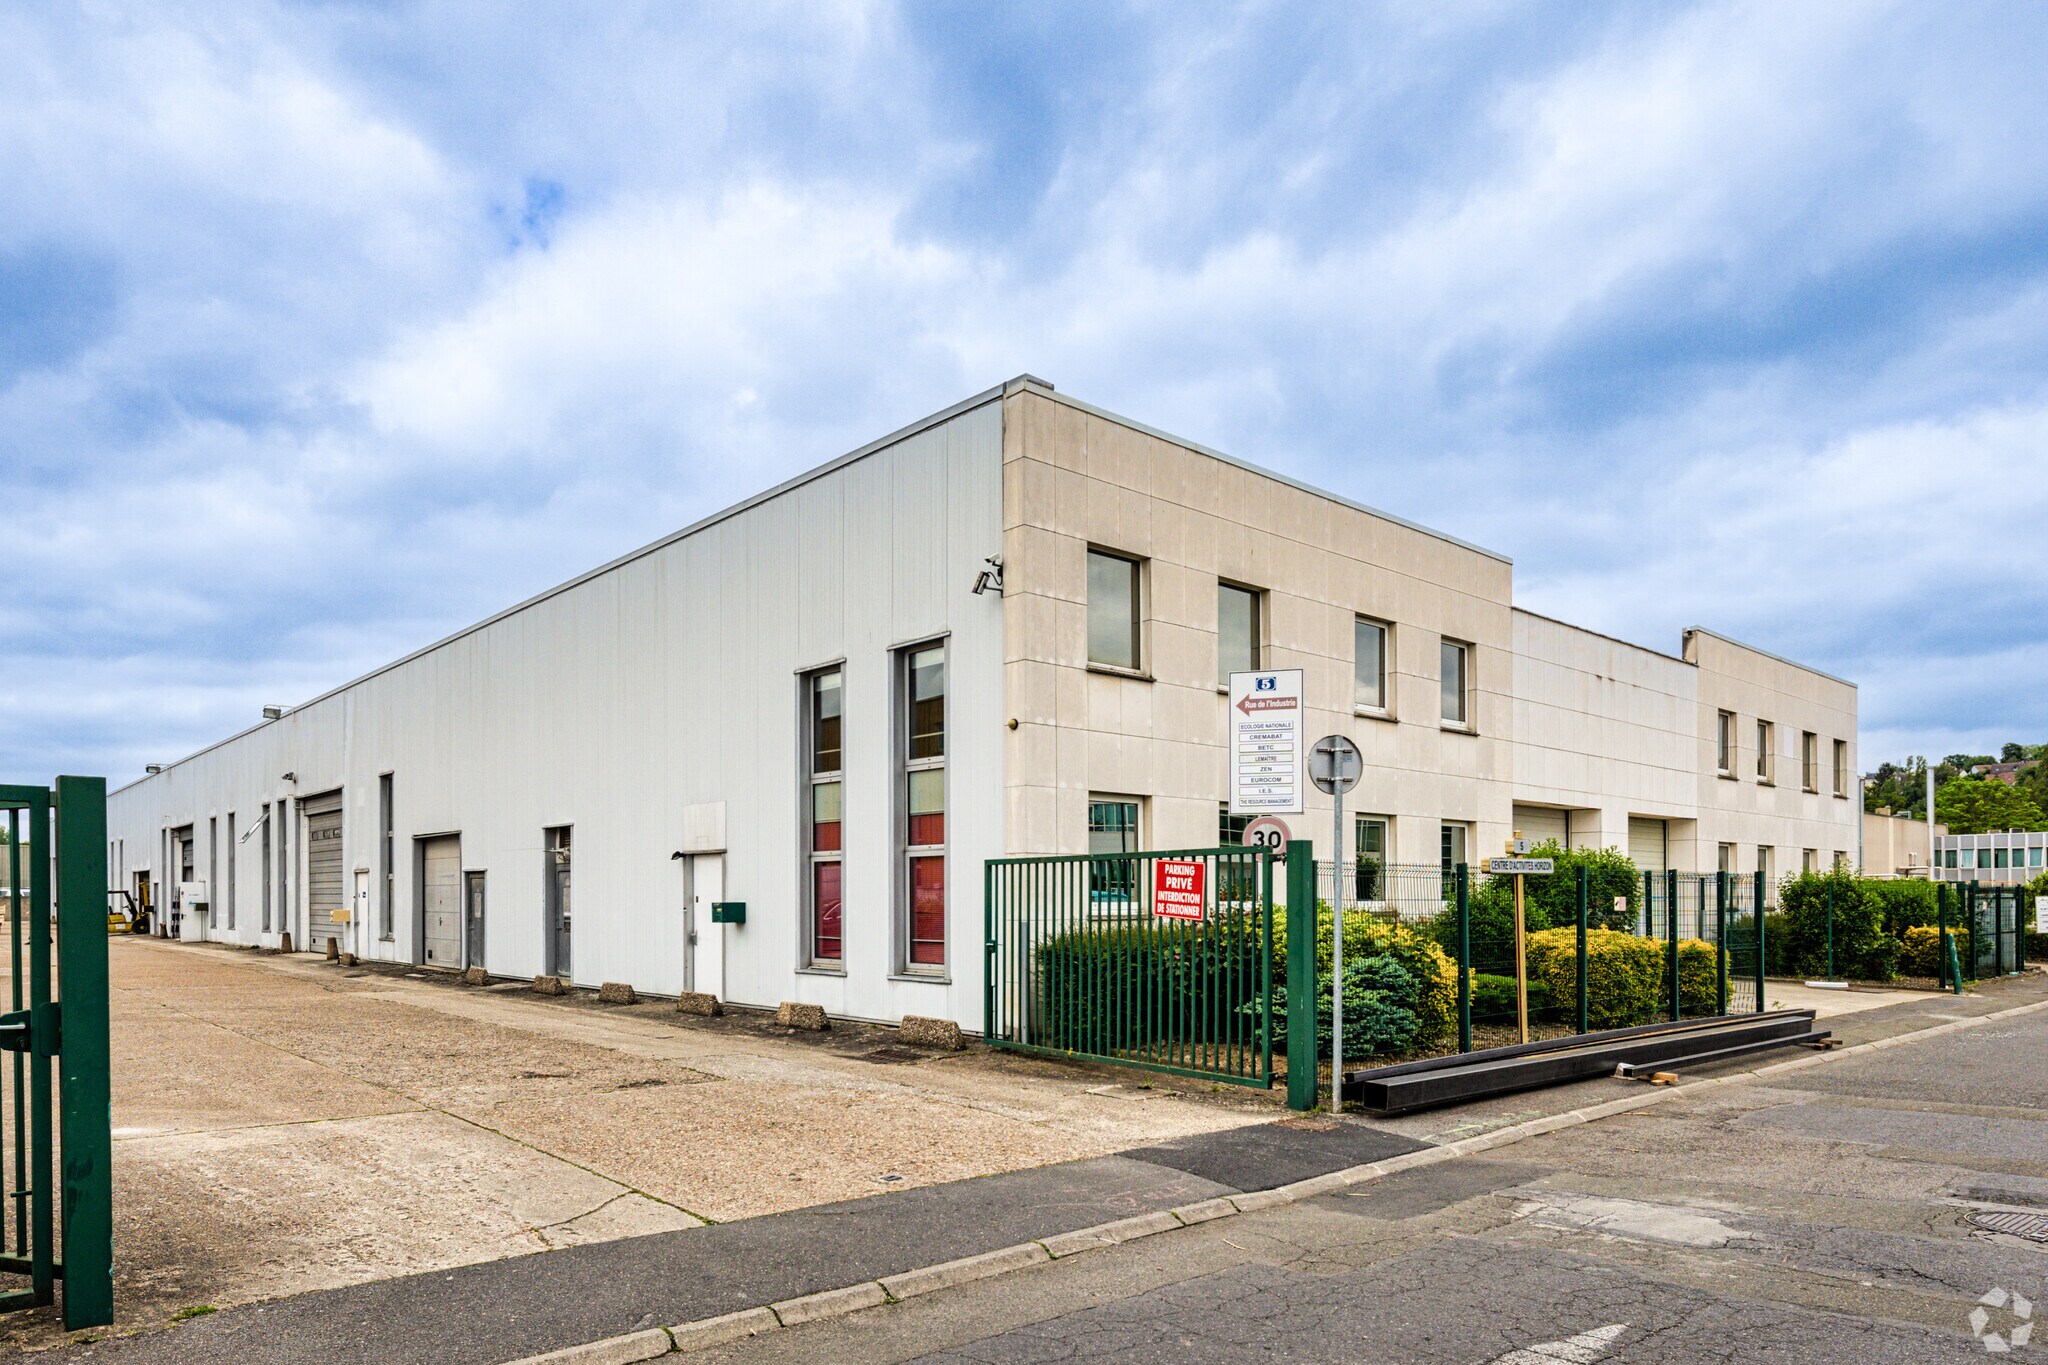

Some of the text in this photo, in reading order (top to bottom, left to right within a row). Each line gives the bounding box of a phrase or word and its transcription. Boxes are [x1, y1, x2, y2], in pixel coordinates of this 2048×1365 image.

[1261, 679, 1271, 690] 5
[1244, 701, 1257, 709] Rue
[1253, 830, 1282, 848] 30
[1164, 864, 1196, 876] PARKING
[1492, 860, 1508, 870] CENTRE
[1166, 876, 1192, 890] PRIVÉ
[1158, 890, 1200, 904] INTERDICTION
[1157, 902, 1200, 916] DE STATIONNER
